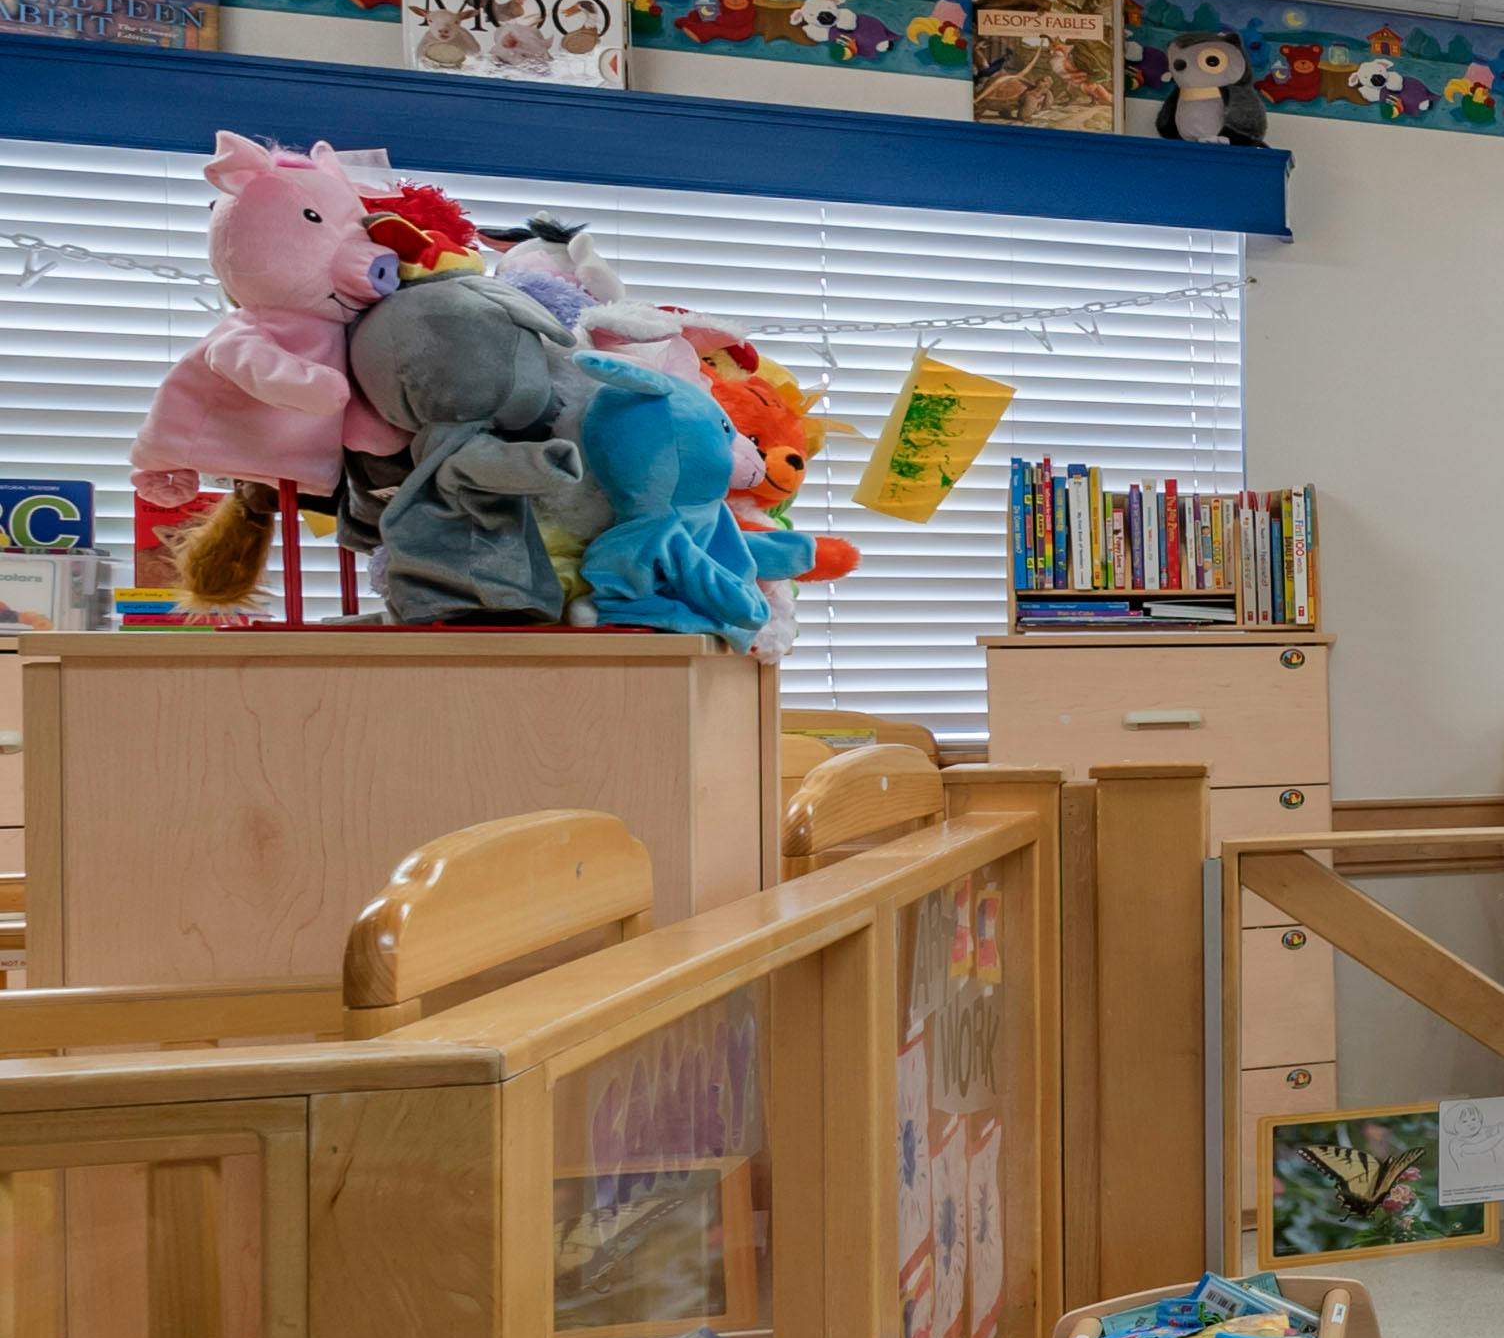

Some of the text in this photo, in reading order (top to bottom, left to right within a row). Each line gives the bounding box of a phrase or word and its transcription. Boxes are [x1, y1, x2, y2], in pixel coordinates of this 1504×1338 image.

[982, 14, 1096, 30] AESOP'S FABLES
[1295, 538, 1305, 557] 100
[940, 992, 1000, 1099] WORK
